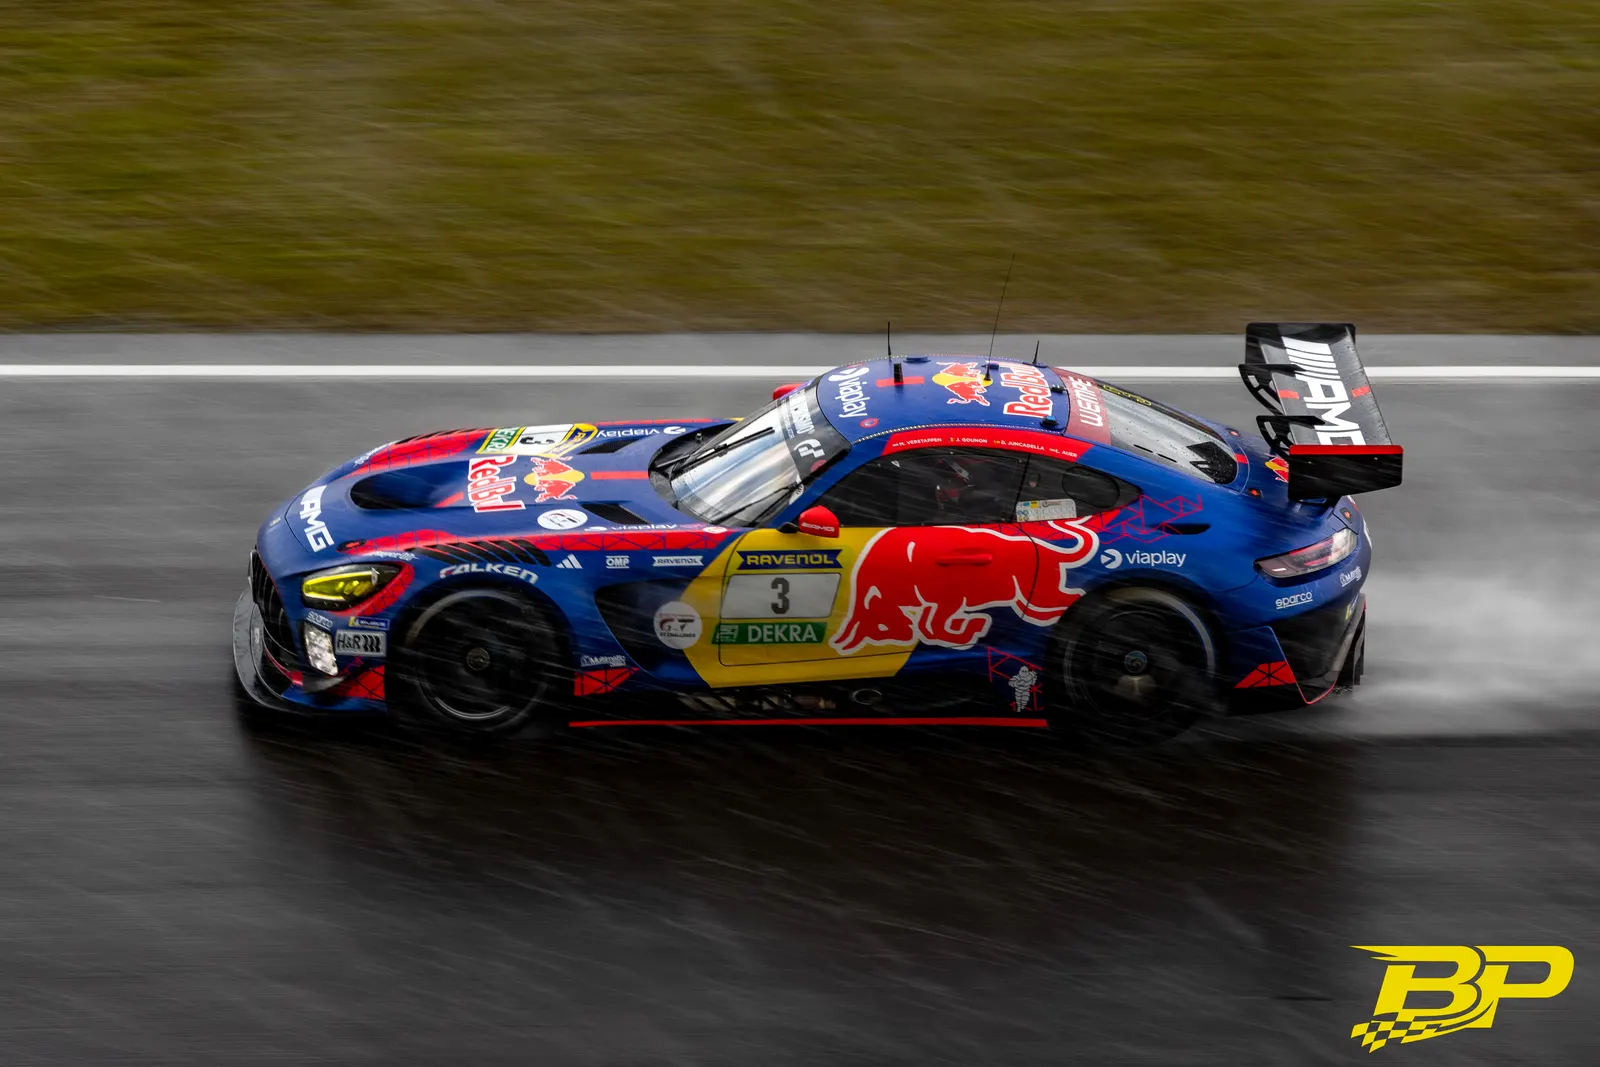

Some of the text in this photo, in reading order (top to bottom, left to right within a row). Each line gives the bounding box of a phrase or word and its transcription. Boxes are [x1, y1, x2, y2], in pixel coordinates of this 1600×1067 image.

[834, 377, 871, 418] viaplay
[1001, 381, 1053, 419] Red
[1068, 375, 1104, 427] WEMPE
[485, 427, 517, 453] EKR
[596, 428, 660, 438] viaplay
[906, 437, 942, 445] VERSTAPPEN
[1008, 441, 1045, 451] JUNCADELLA
[1061, 450, 1078, 458] AUER
[299, 498, 335, 553] AMG
[605, 557, 630, 568] OMP
[746, 554, 835, 566] RAVENOL
[1125, 550, 1187, 568] viaplay
[439, 563, 539, 585] FALKEN
[770, 577, 790, 615] 3
[1275, 591, 1313, 610] sparco
[747, 623, 818, 643] DEKRA
